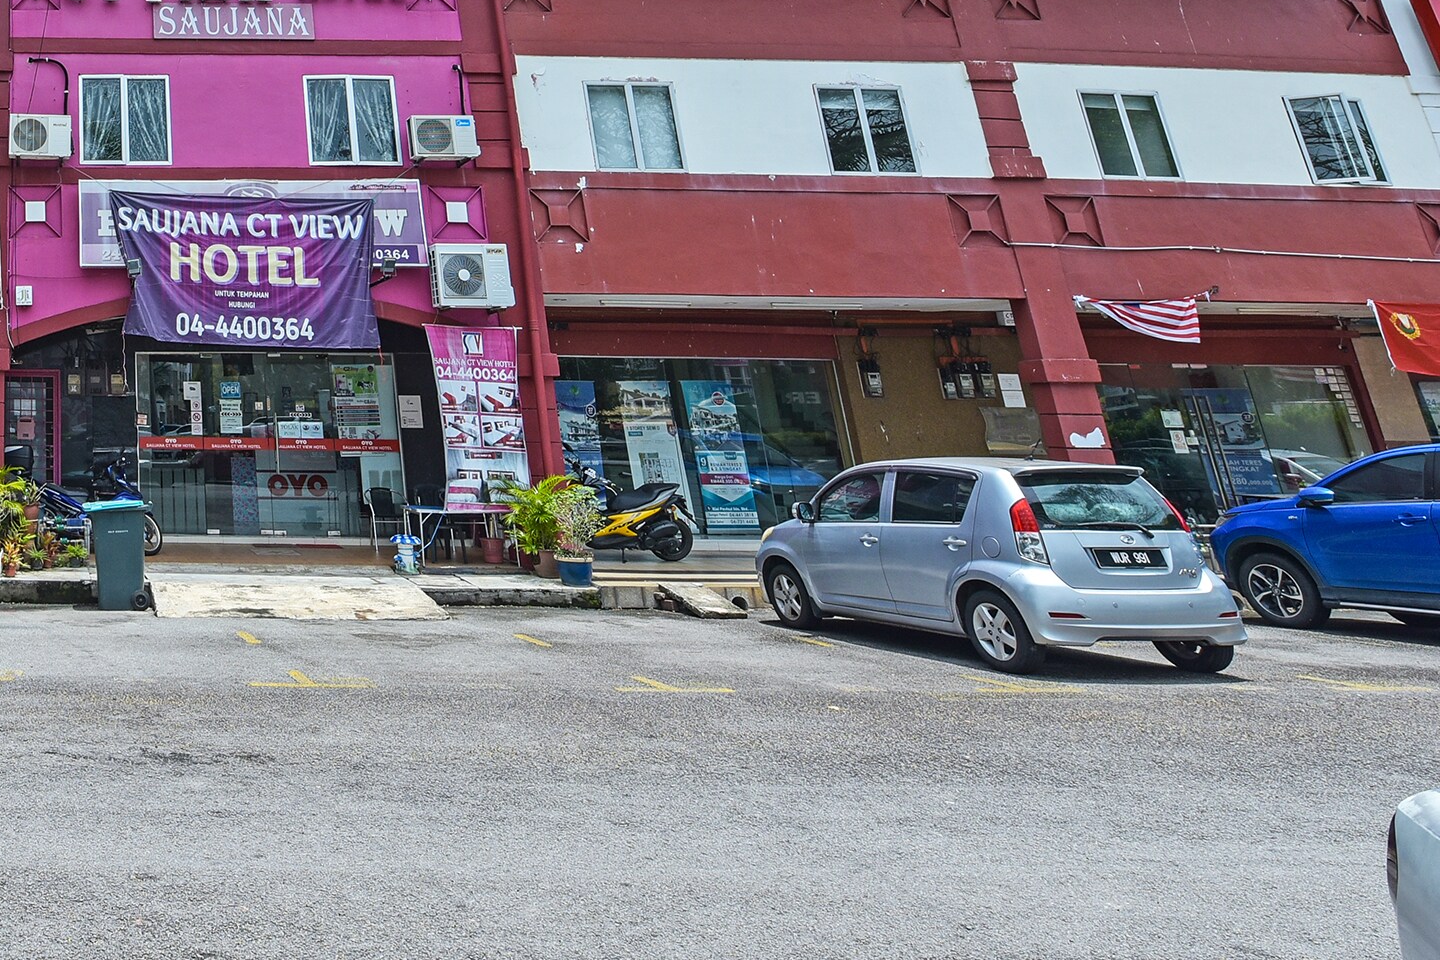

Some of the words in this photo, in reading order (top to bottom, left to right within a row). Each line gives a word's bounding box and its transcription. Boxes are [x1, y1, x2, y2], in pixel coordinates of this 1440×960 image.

[158, 5, 311, 36] SAUJANA
[117, 206, 240, 239] SAUJANA
[245, 212, 283, 240] CT
[287, 213, 366, 240] VIEW
[167, 241, 322, 289] HOTEL
[214, 289, 235, 299] UNTUK
[236, 290, 270, 299] TEMPAHAN
[228, 301, 256, 309] HUBUNGI
[175, 311, 315, 341] 04-4400364
[433, 357, 466, 366] SAUJANA
[477, 359, 493, 367] VIEW
[494, 360, 516, 368] HOTEL
[435, 365, 515, 381] 04-4400364
[222, 386, 239, 395] OPEN
[267, 474, 329, 498] OYO
[1133, 552, 1152, 564] 991
